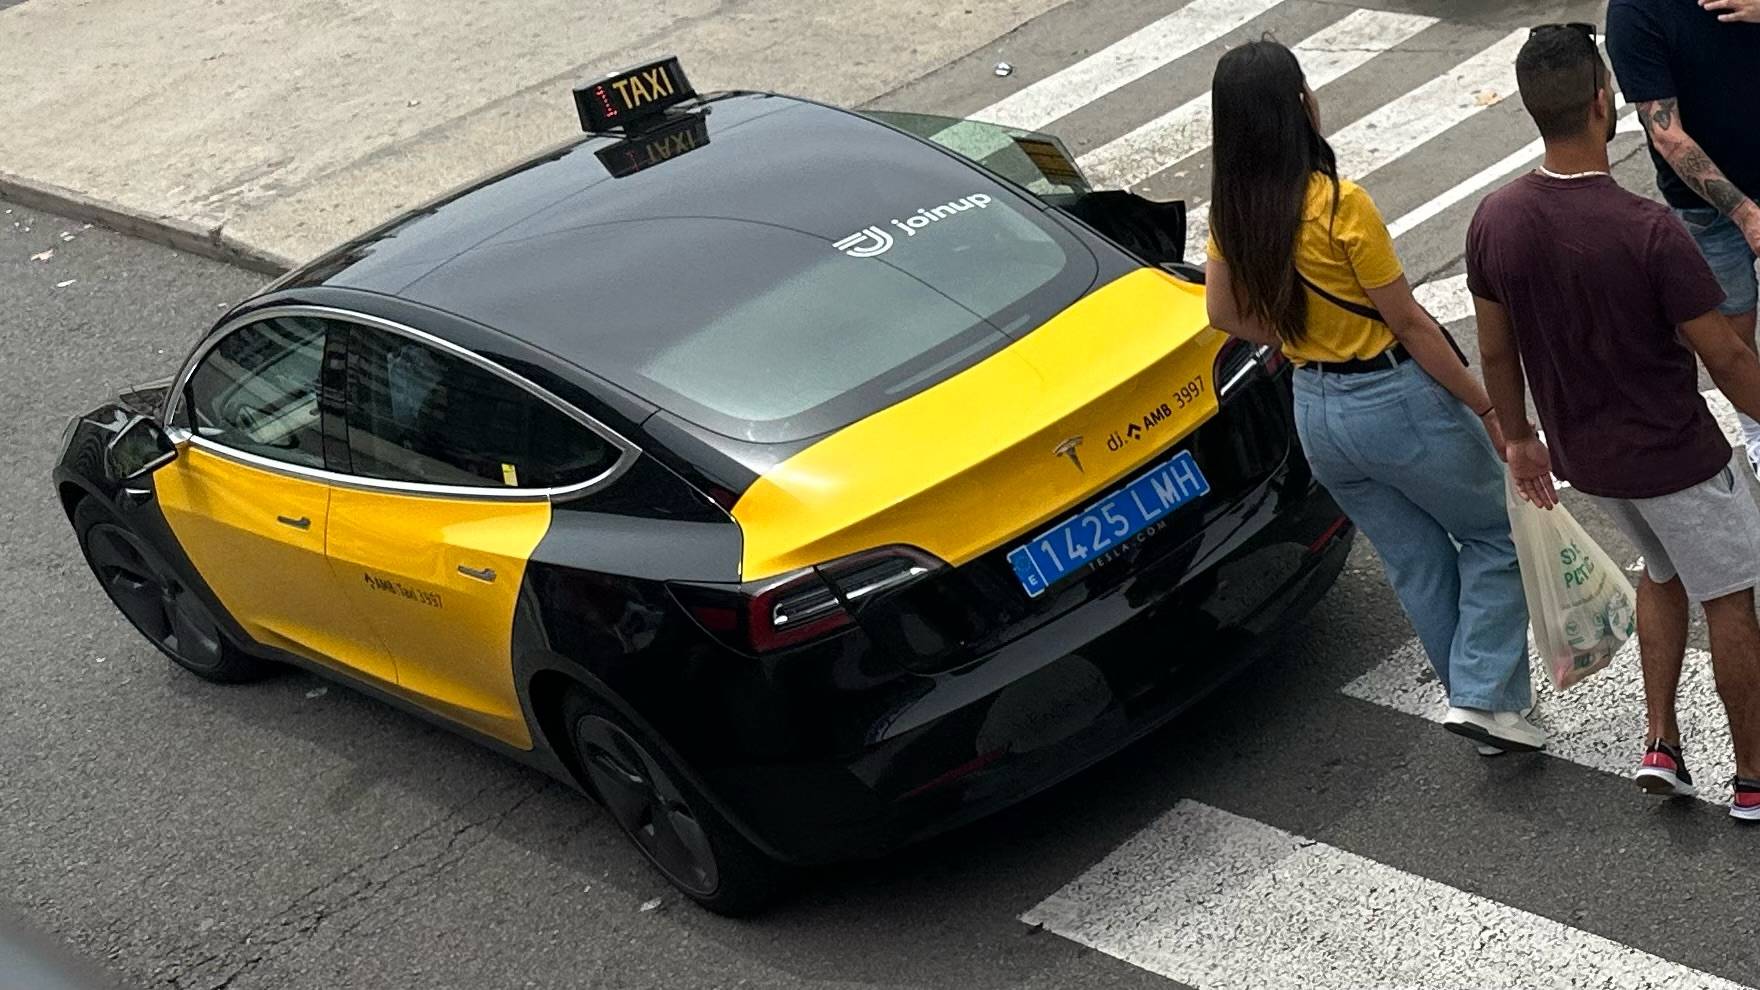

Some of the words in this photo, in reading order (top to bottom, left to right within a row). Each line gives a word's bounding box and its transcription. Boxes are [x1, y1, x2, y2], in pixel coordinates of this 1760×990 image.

[612, 66, 675, 110] TAXI
[890, 193, 992, 237] joinup
[1143, 403, 1172, 432] AMB
[1172, 374, 1205, 409] 3997
[1028, 573, 1039, 586] E
[1040, 502, 1130, 573] 1425
[1130, 459, 1201, 522] LMH
